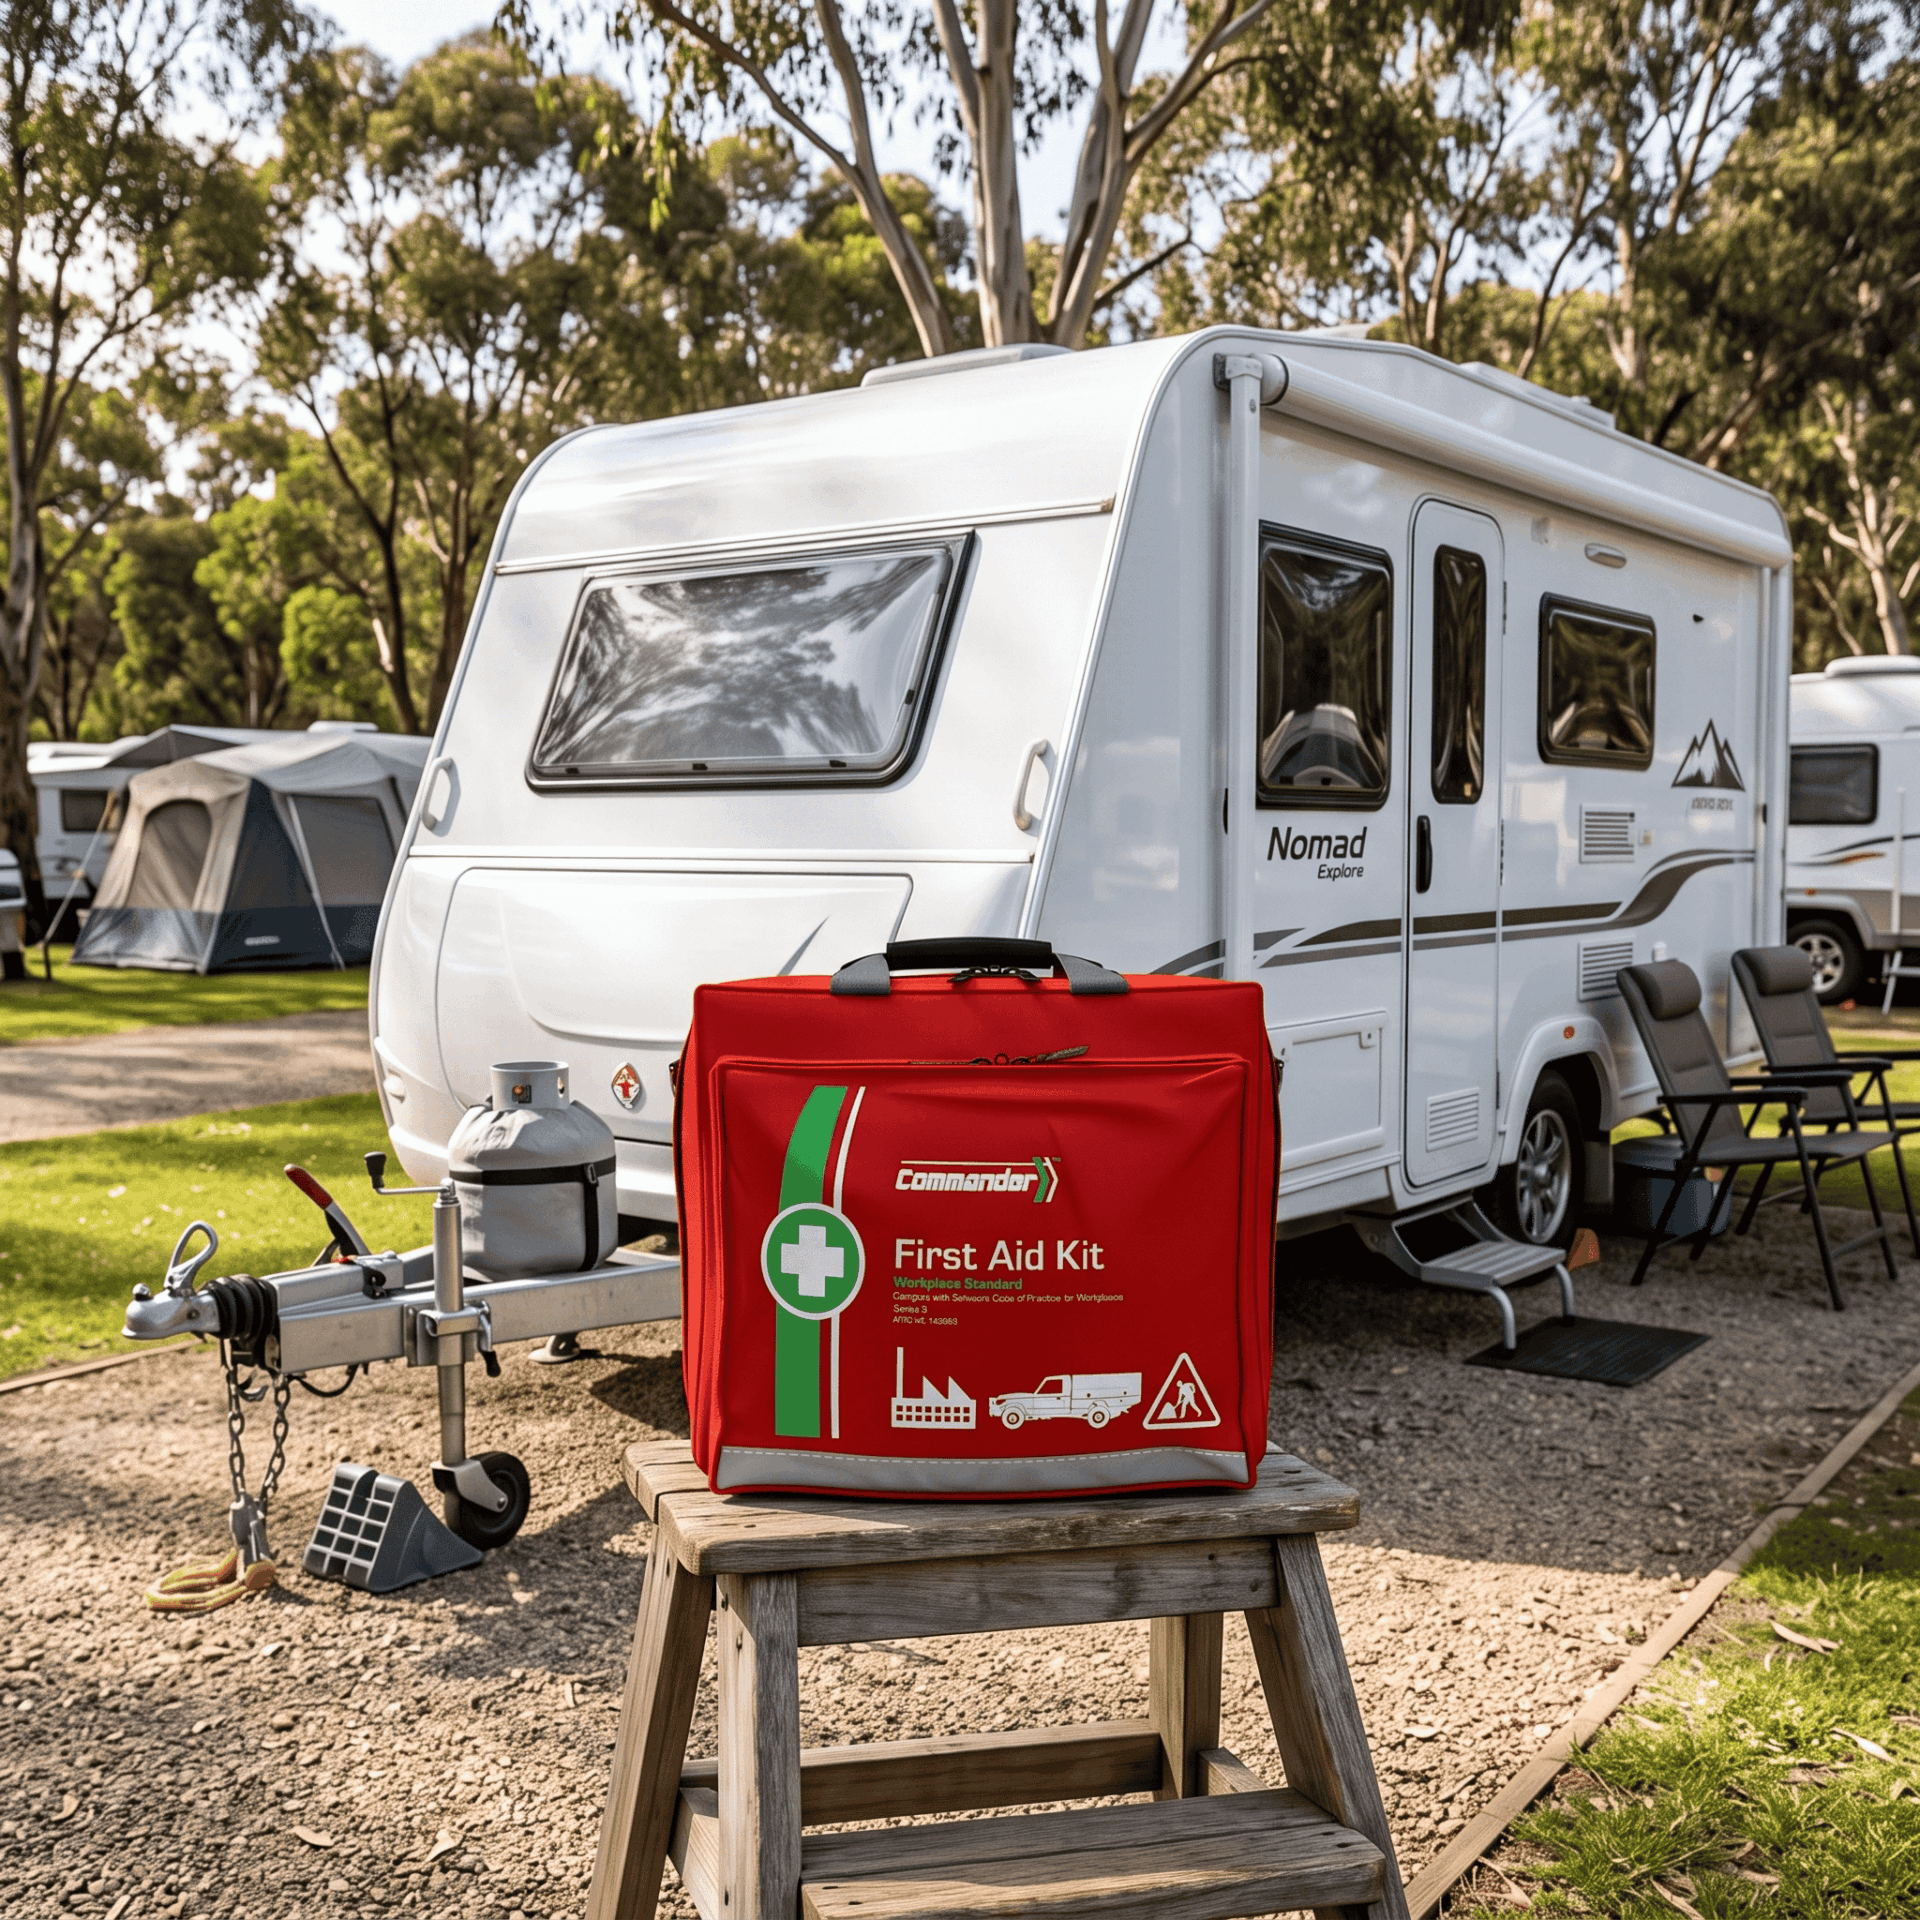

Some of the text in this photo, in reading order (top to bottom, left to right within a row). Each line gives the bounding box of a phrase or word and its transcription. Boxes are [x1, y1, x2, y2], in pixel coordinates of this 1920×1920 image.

[1267, 826, 1367, 861] Nomad
[1318, 863, 1364, 881] Explore
[895, 1167, 1038, 1192] Commander
[895, 1238, 1105, 1271] First Aid Kit
[964, 1277, 1023, 1290] Standard
[932, 1293, 950, 1302] with
